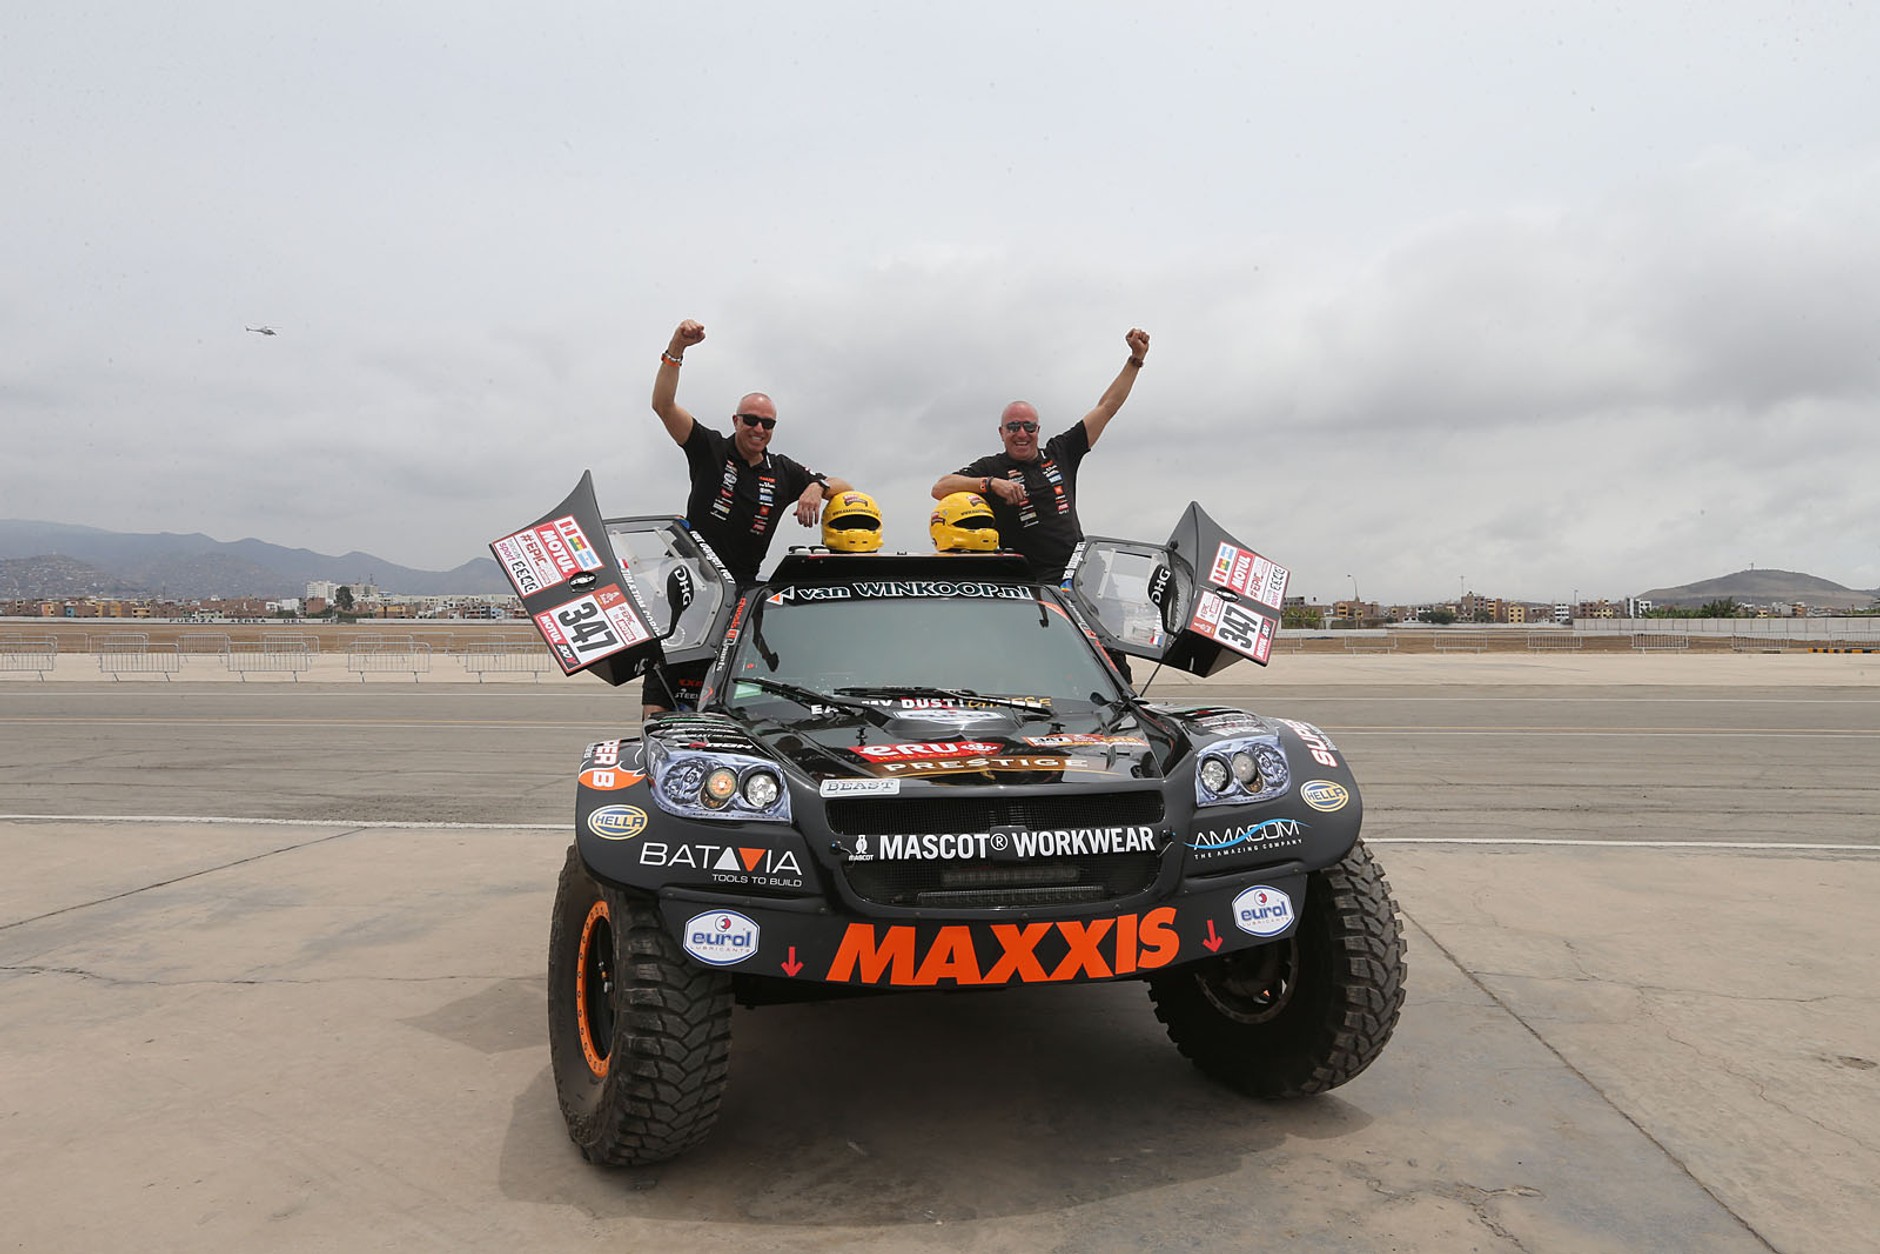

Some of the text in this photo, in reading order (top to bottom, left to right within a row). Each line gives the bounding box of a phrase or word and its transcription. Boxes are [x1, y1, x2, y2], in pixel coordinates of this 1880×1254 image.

[541, 530, 576, 573] MOTUL
[1232, 555, 1251, 589] MOTUL
[797, 582, 1033, 600] van WINKOOP.nl
[540, 615, 563, 643] MOTUL
[558, 602, 618, 653] 347
[1219, 605, 1257, 649] 347
[884, 758, 1088, 771] PRESTIGE
[827, 782, 894, 791] BEAST
[1306, 787, 1346, 800] HELLA
[595, 816, 645, 828] HELLA
[1011, 827, 1156, 857] WORKWEAR
[1194, 820, 1300, 850] AMACOM
[639, 842, 803, 876] BATAVIA
[1217, 845, 1259, 857] AMAZING
[1262, 839, 1302, 850] COMPANY
[712, 873, 803, 888] TOOLS TO BUILD
[1241, 901, 1288, 921] eurol
[692, 931, 751, 947] eurol
[825, 906, 1180, 986] MAXXIS
